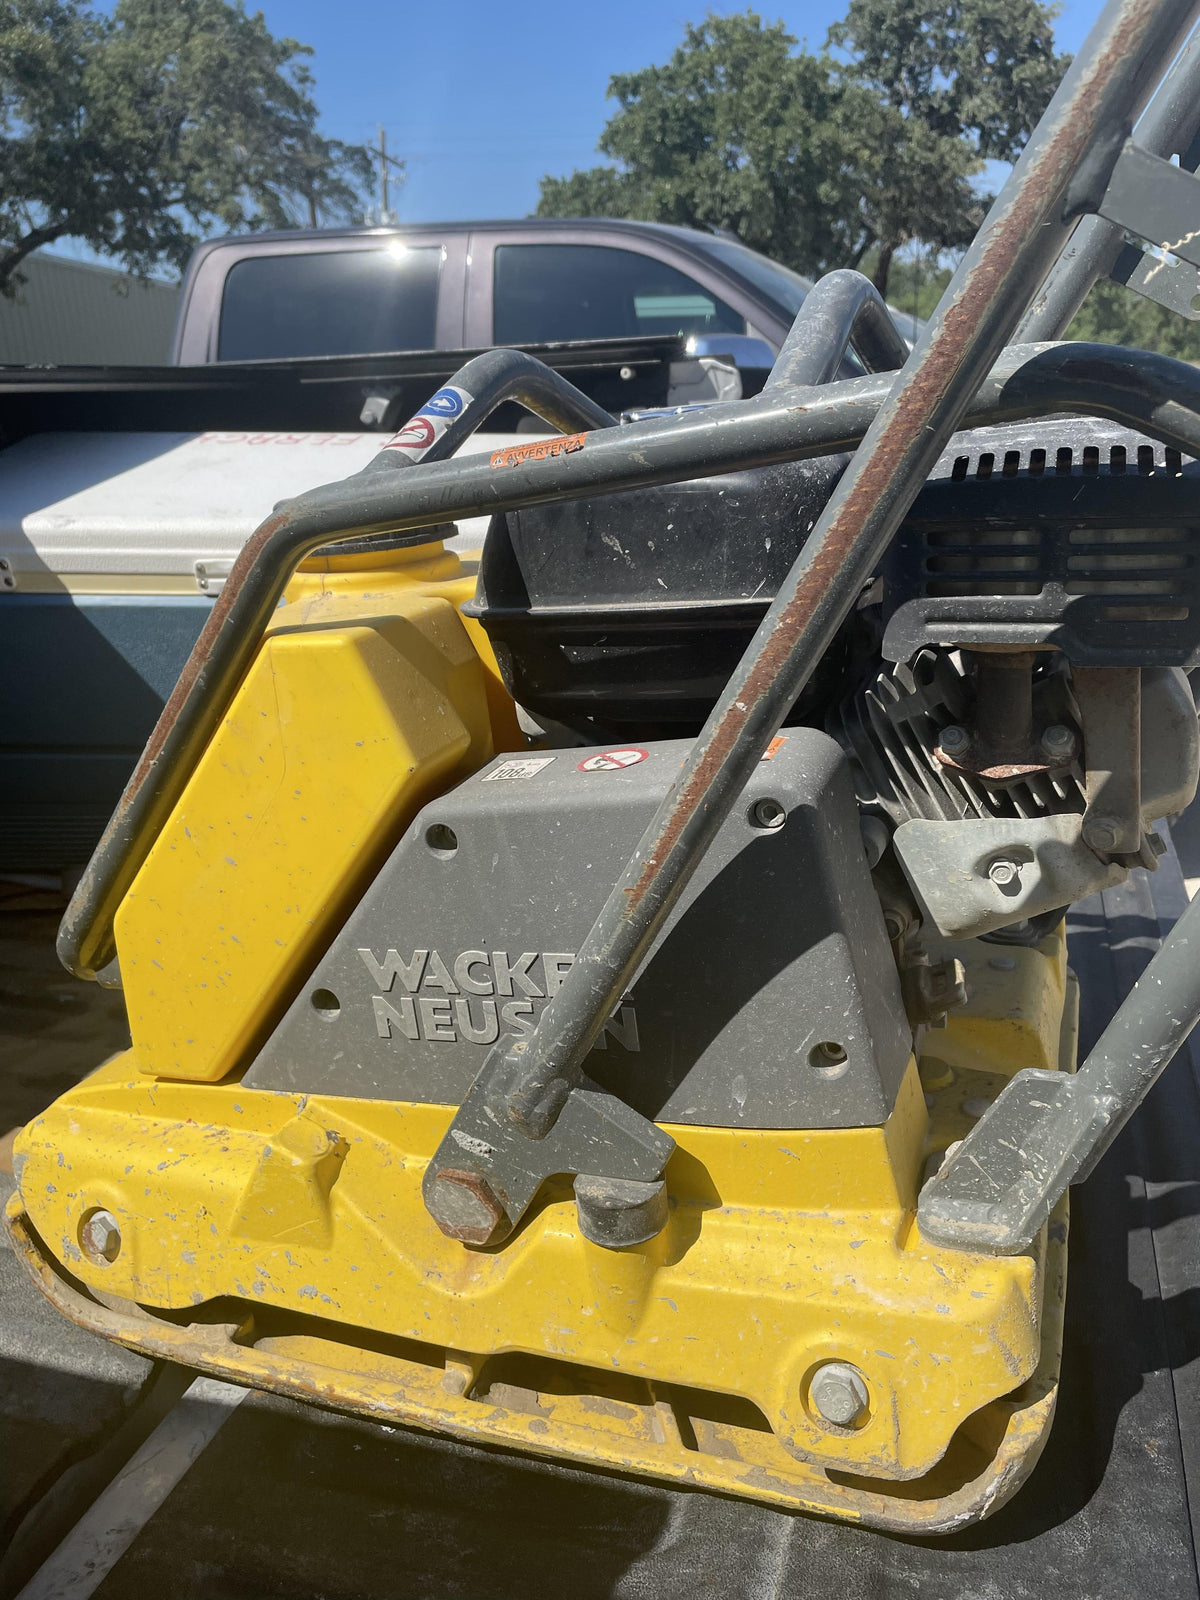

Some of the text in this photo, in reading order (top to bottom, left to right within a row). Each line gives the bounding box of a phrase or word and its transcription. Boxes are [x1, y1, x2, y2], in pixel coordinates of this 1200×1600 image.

[506, 440, 581, 462] AVVERTENZA
[357, 947, 634, 1001] WACKE
[372, 995, 641, 1052] NEUSN
